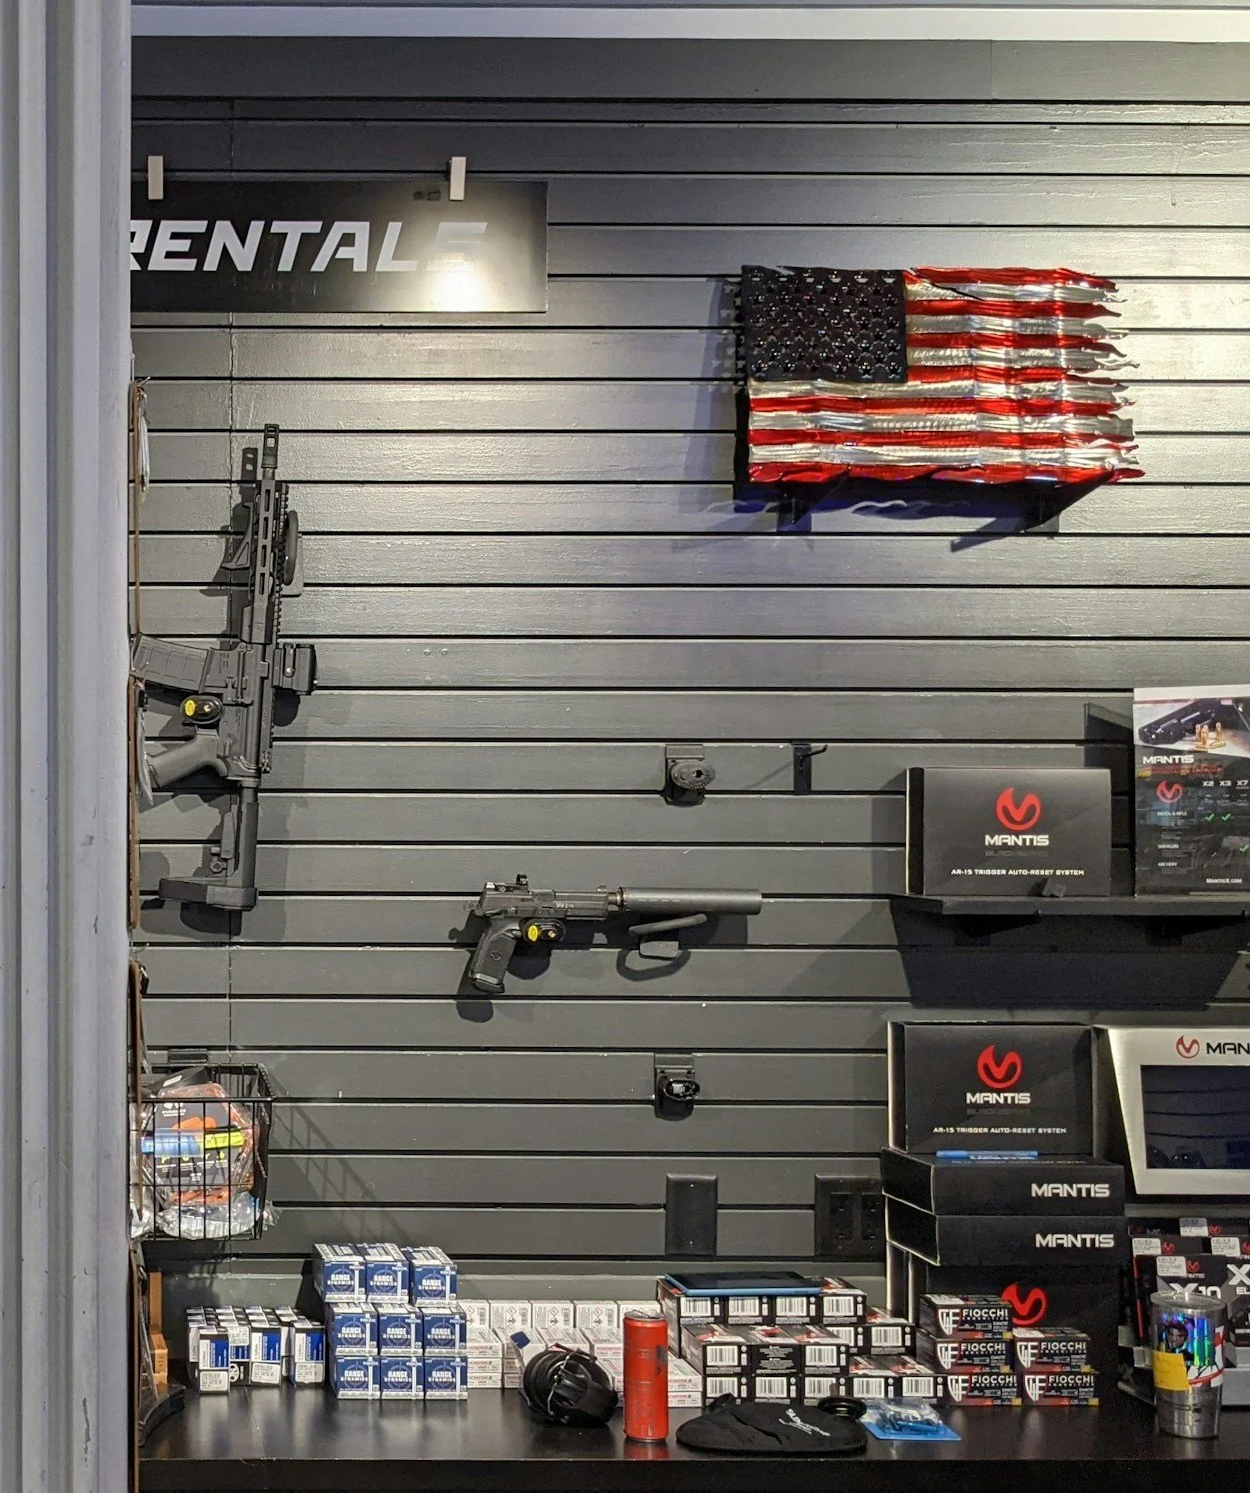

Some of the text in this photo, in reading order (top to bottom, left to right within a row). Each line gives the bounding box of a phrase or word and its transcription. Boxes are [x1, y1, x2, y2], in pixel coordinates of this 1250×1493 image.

[1143, 755, 1194, 764] MANTIS
[985, 834, 1050, 846] MANTIS
[966, 1092, 1031, 1105] MANTIS
[1031, 1183, 1110, 1198] MANTIS
[1035, 1233, 1115, 1248] MANTIS
[962, 1309, 1008, 1317] FIOCCHI
[960, 1343, 1005, 1351] FIOCCHI
[1041, 1342, 1086, 1350] FIOCCHI
[971, 1375, 1016, 1383] FIOCCHI
[1049, 1375, 1094, 1383] FIOCCHI
